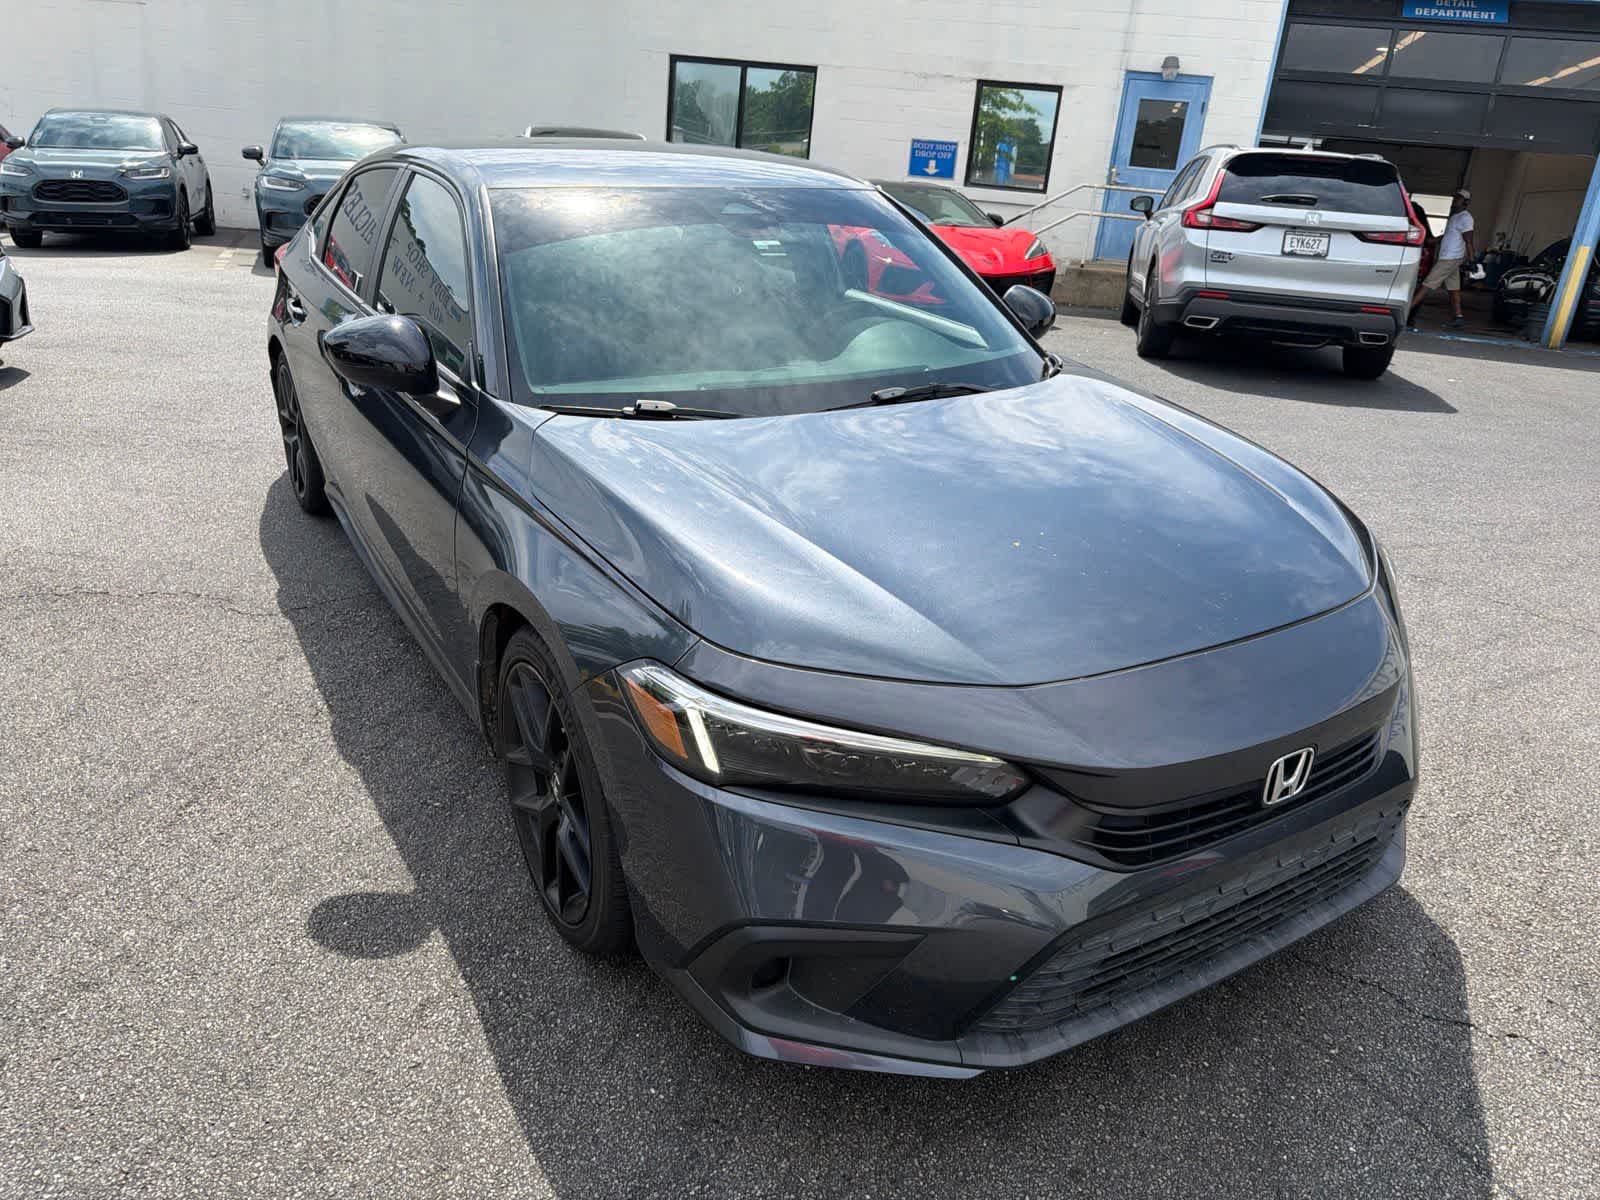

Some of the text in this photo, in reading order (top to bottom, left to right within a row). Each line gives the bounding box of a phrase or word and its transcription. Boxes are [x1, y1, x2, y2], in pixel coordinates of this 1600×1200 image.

[1435, 0, 1478, 8] DETAIL
[1415, 7, 1497, 20] DEPARTMENT
[912, 142, 936, 151] BODY
[915, 150, 936, 158] DROP
[1290, 236, 1322, 250] EYK627
